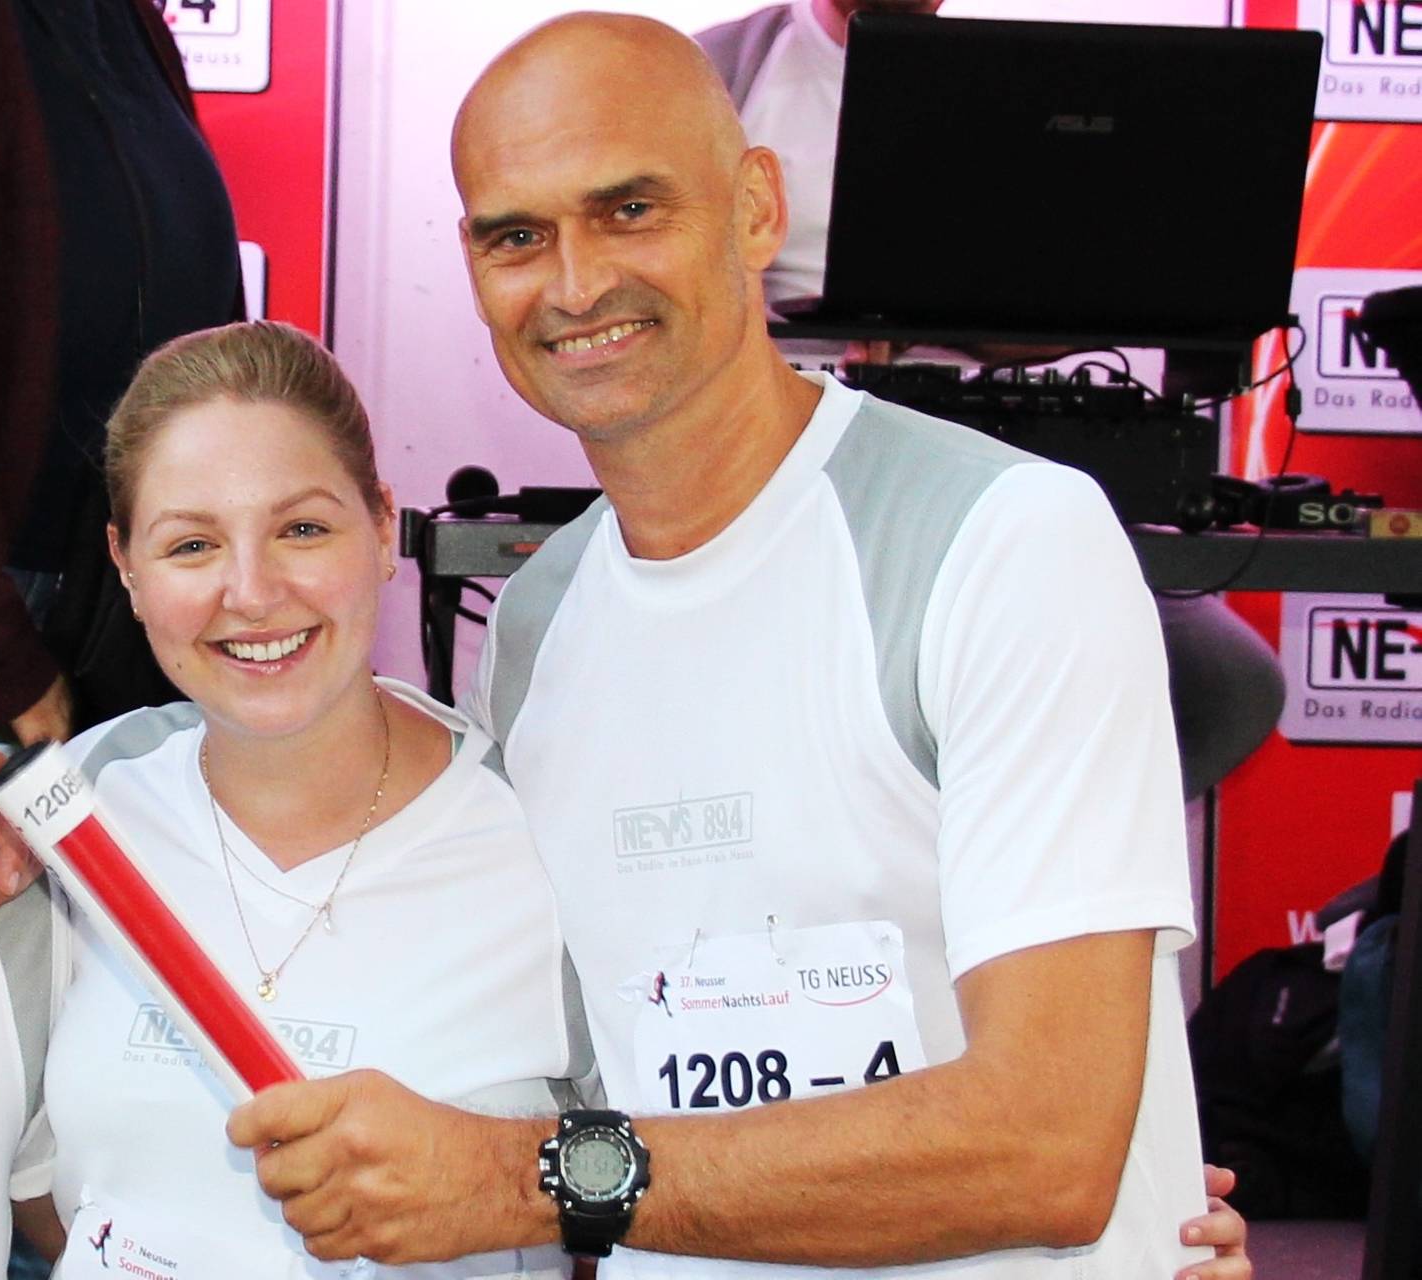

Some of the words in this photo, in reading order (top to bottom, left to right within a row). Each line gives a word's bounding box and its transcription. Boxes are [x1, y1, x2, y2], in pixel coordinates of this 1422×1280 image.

[1323, 74, 1364, 94] Das
[1314, 387, 1355, 407] Das
[1305, 698, 1346, 718] Das
[703, 799, 743, 841] 89.4
[694, 975, 726, 987] Neusser
[798, 969, 820, 990] TG
[826, 964, 889, 989] NEUSS
[680, 991, 790, 1011] SommerNachtsLauf
[658, 1049, 791, 1109] 1208
[864, 1041, 903, 1085] 4
[121, 1237, 137, 1253] 37.
[139, 1246, 178, 1269] Neusser
